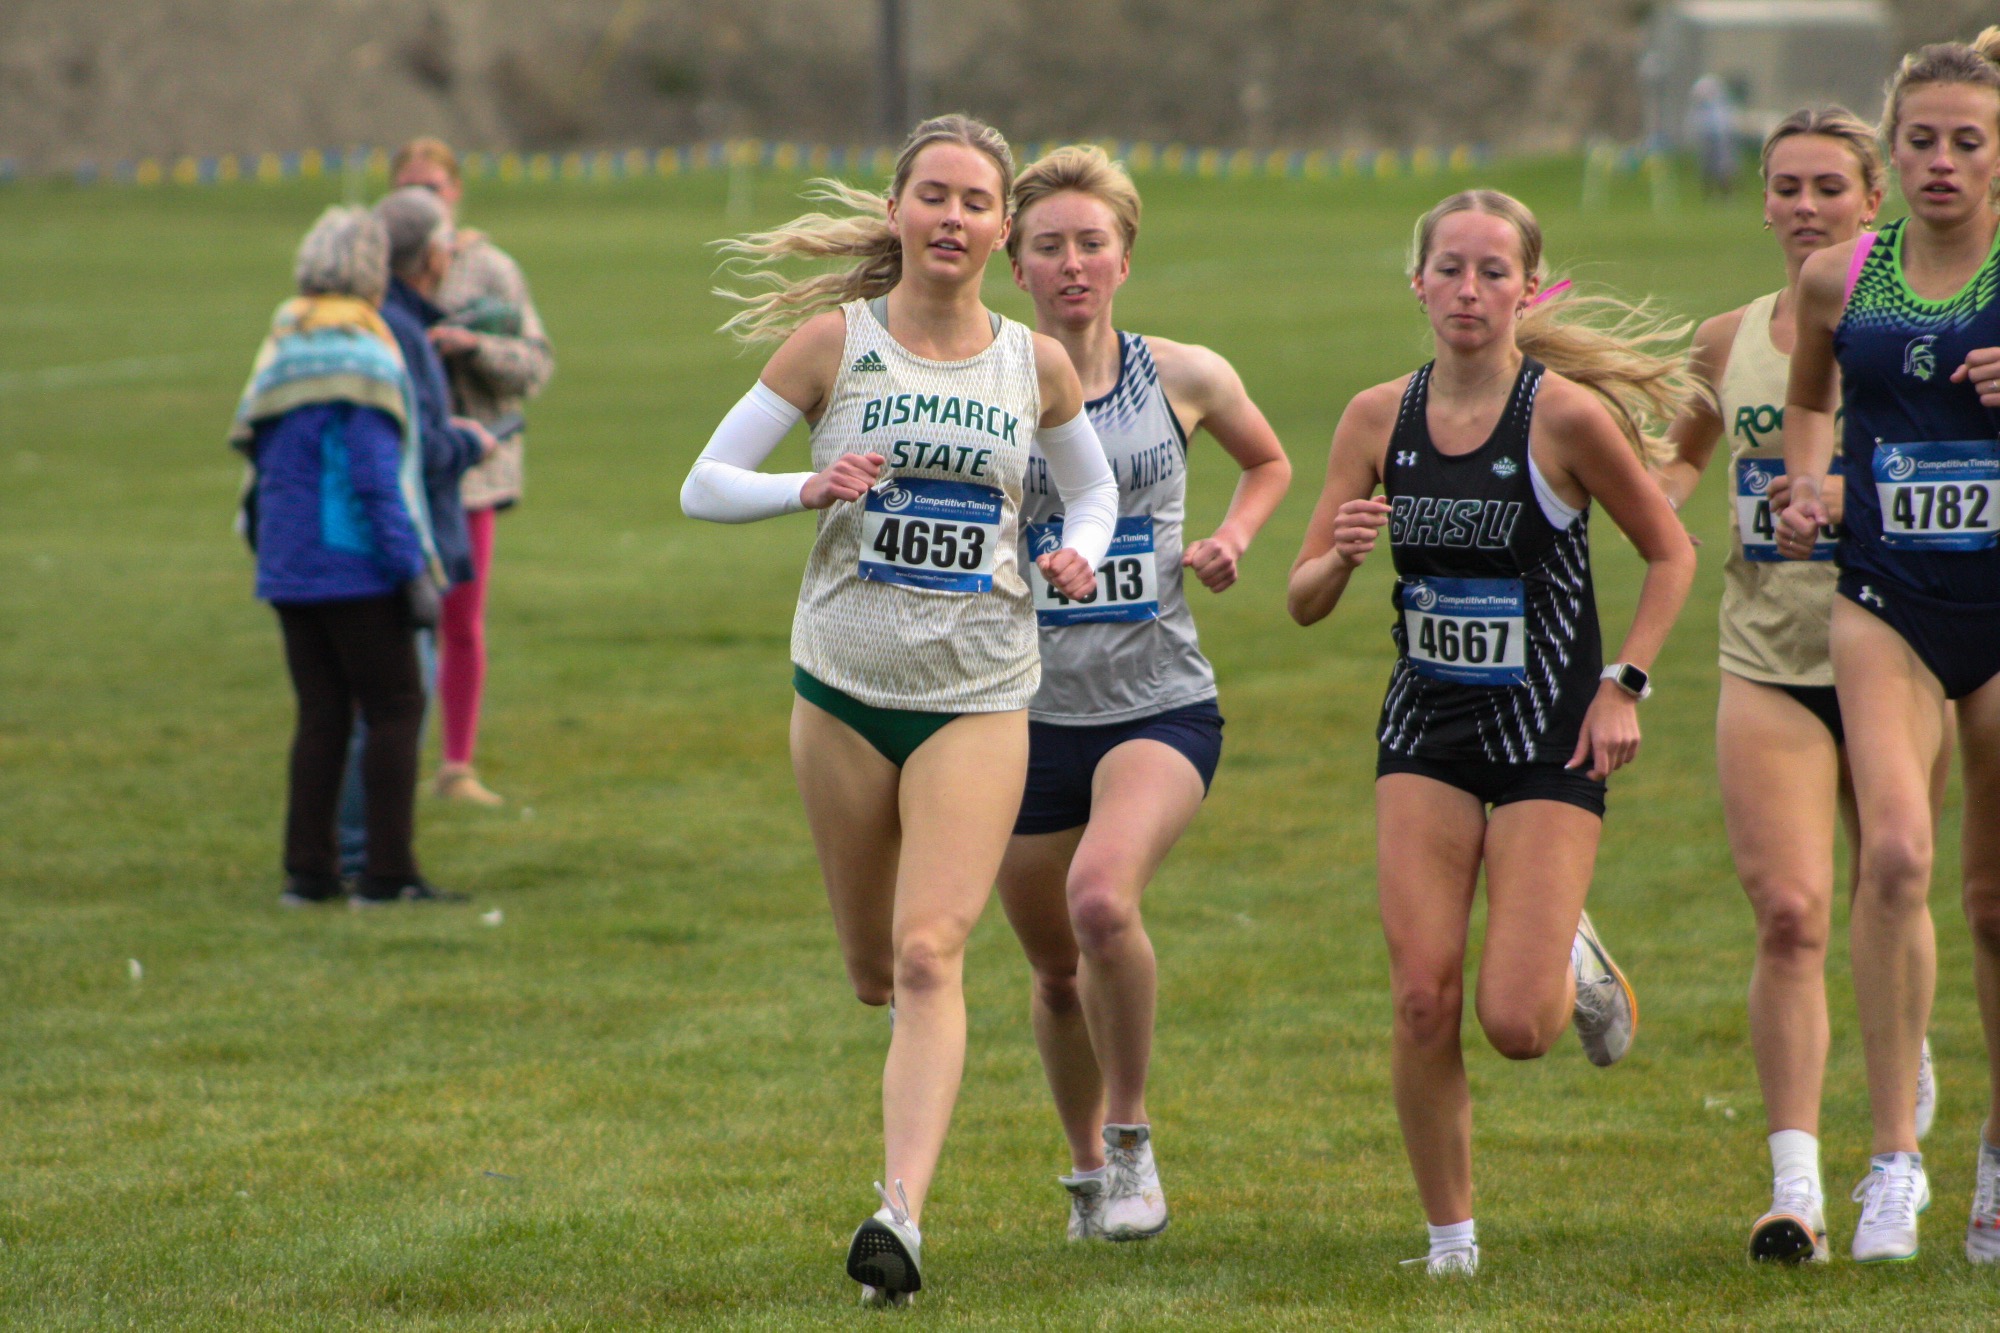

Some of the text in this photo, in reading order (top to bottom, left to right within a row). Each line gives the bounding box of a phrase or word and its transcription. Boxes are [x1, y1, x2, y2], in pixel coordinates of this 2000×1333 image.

[851, 362, 888, 372] adidas
[861, 394, 1019, 447] BISMARCK
[891, 440, 992, 477] STATE
[1130, 439, 1173, 491] MINES
[1492, 463, 1516, 472] RMAC
[1917, 458, 1999, 469] Competitive Timing
[914, 495, 996, 512] Competitive Timing
[1390, 496, 1522, 549] BHSU
[1892, 483, 1989, 530] 4782
[873, 517, 986, 570] 4653
[1122, 533, 1149, 543] Timing
[1047, 558, 1143, 606] 413
[1438, 595, 1517, 606] Competitive Timing
[1419, 616, 1509, 664] 4667
